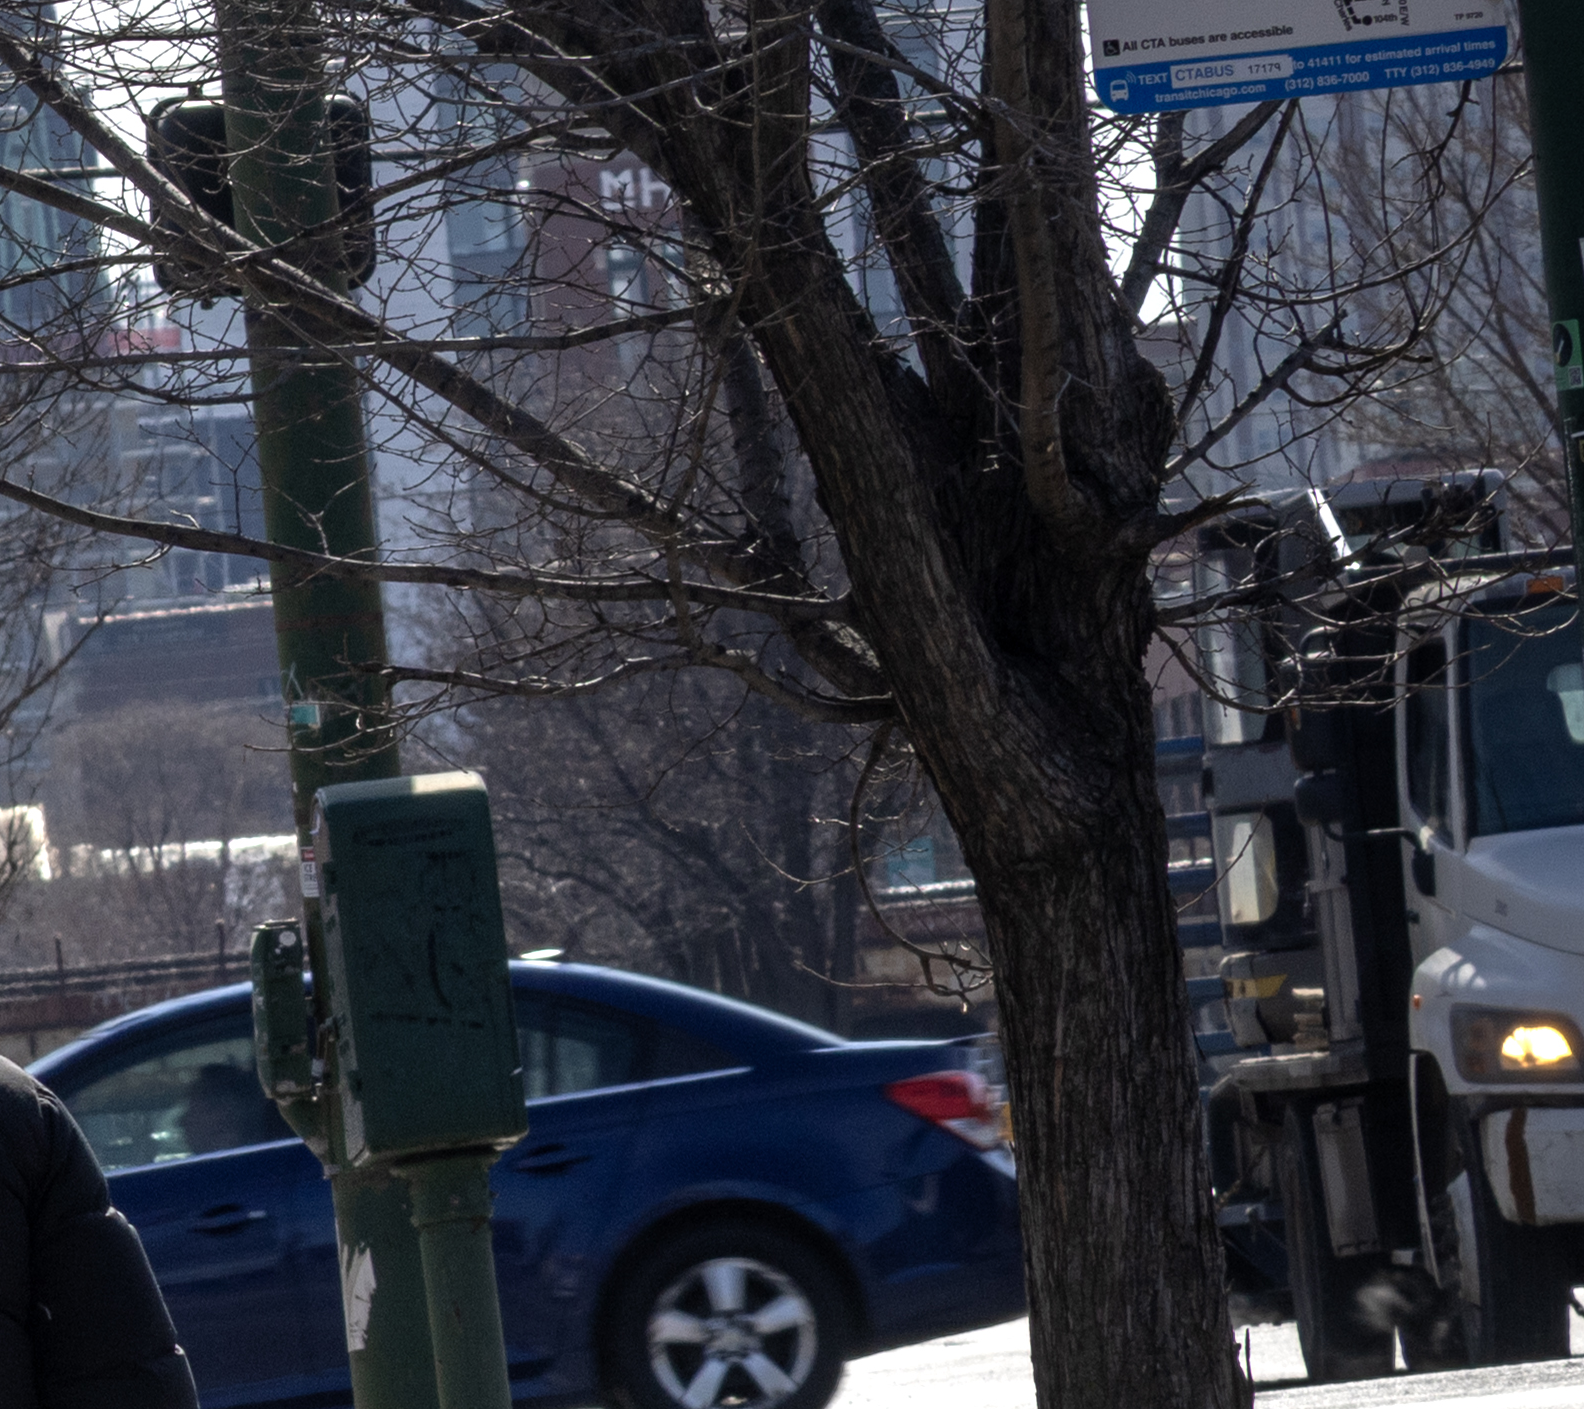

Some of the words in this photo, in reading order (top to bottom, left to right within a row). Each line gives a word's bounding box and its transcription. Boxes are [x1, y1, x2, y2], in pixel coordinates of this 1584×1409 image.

[1123, 41, 1137, 52] All
[1141, 38, 1166, 49] CTA
[1169, 35, 1205, 47] buses
[1208, 31, 1227, 42] are
[1231, 25, 1293, 40] accessible
[1138, 72, 1168, 85] TEXT
[1175, 65, 1234, 81] CTABUS
[1248, 62, 1282, 74] 17179
[1293, 61, 1305, 71] to
[1307, 56, 1341, 68] 41411
[1345, 53, 1362, 64] for
[1365, 46, 1421, 62] estimated
[1425, 43, 1461, 55] arrival
[1463, 39, 1496, 51] times
[1155, 83, 1266, 103] transitchicago.com
[1285, 77, 1315, 91] (312)
[1317, 72, 1369, 86] 836-7000
[1384, 67, 1407, 79] TTY
[1411, 64, 1440, 78] (312)
[1443, 58, 1496, 73] 836-4949
